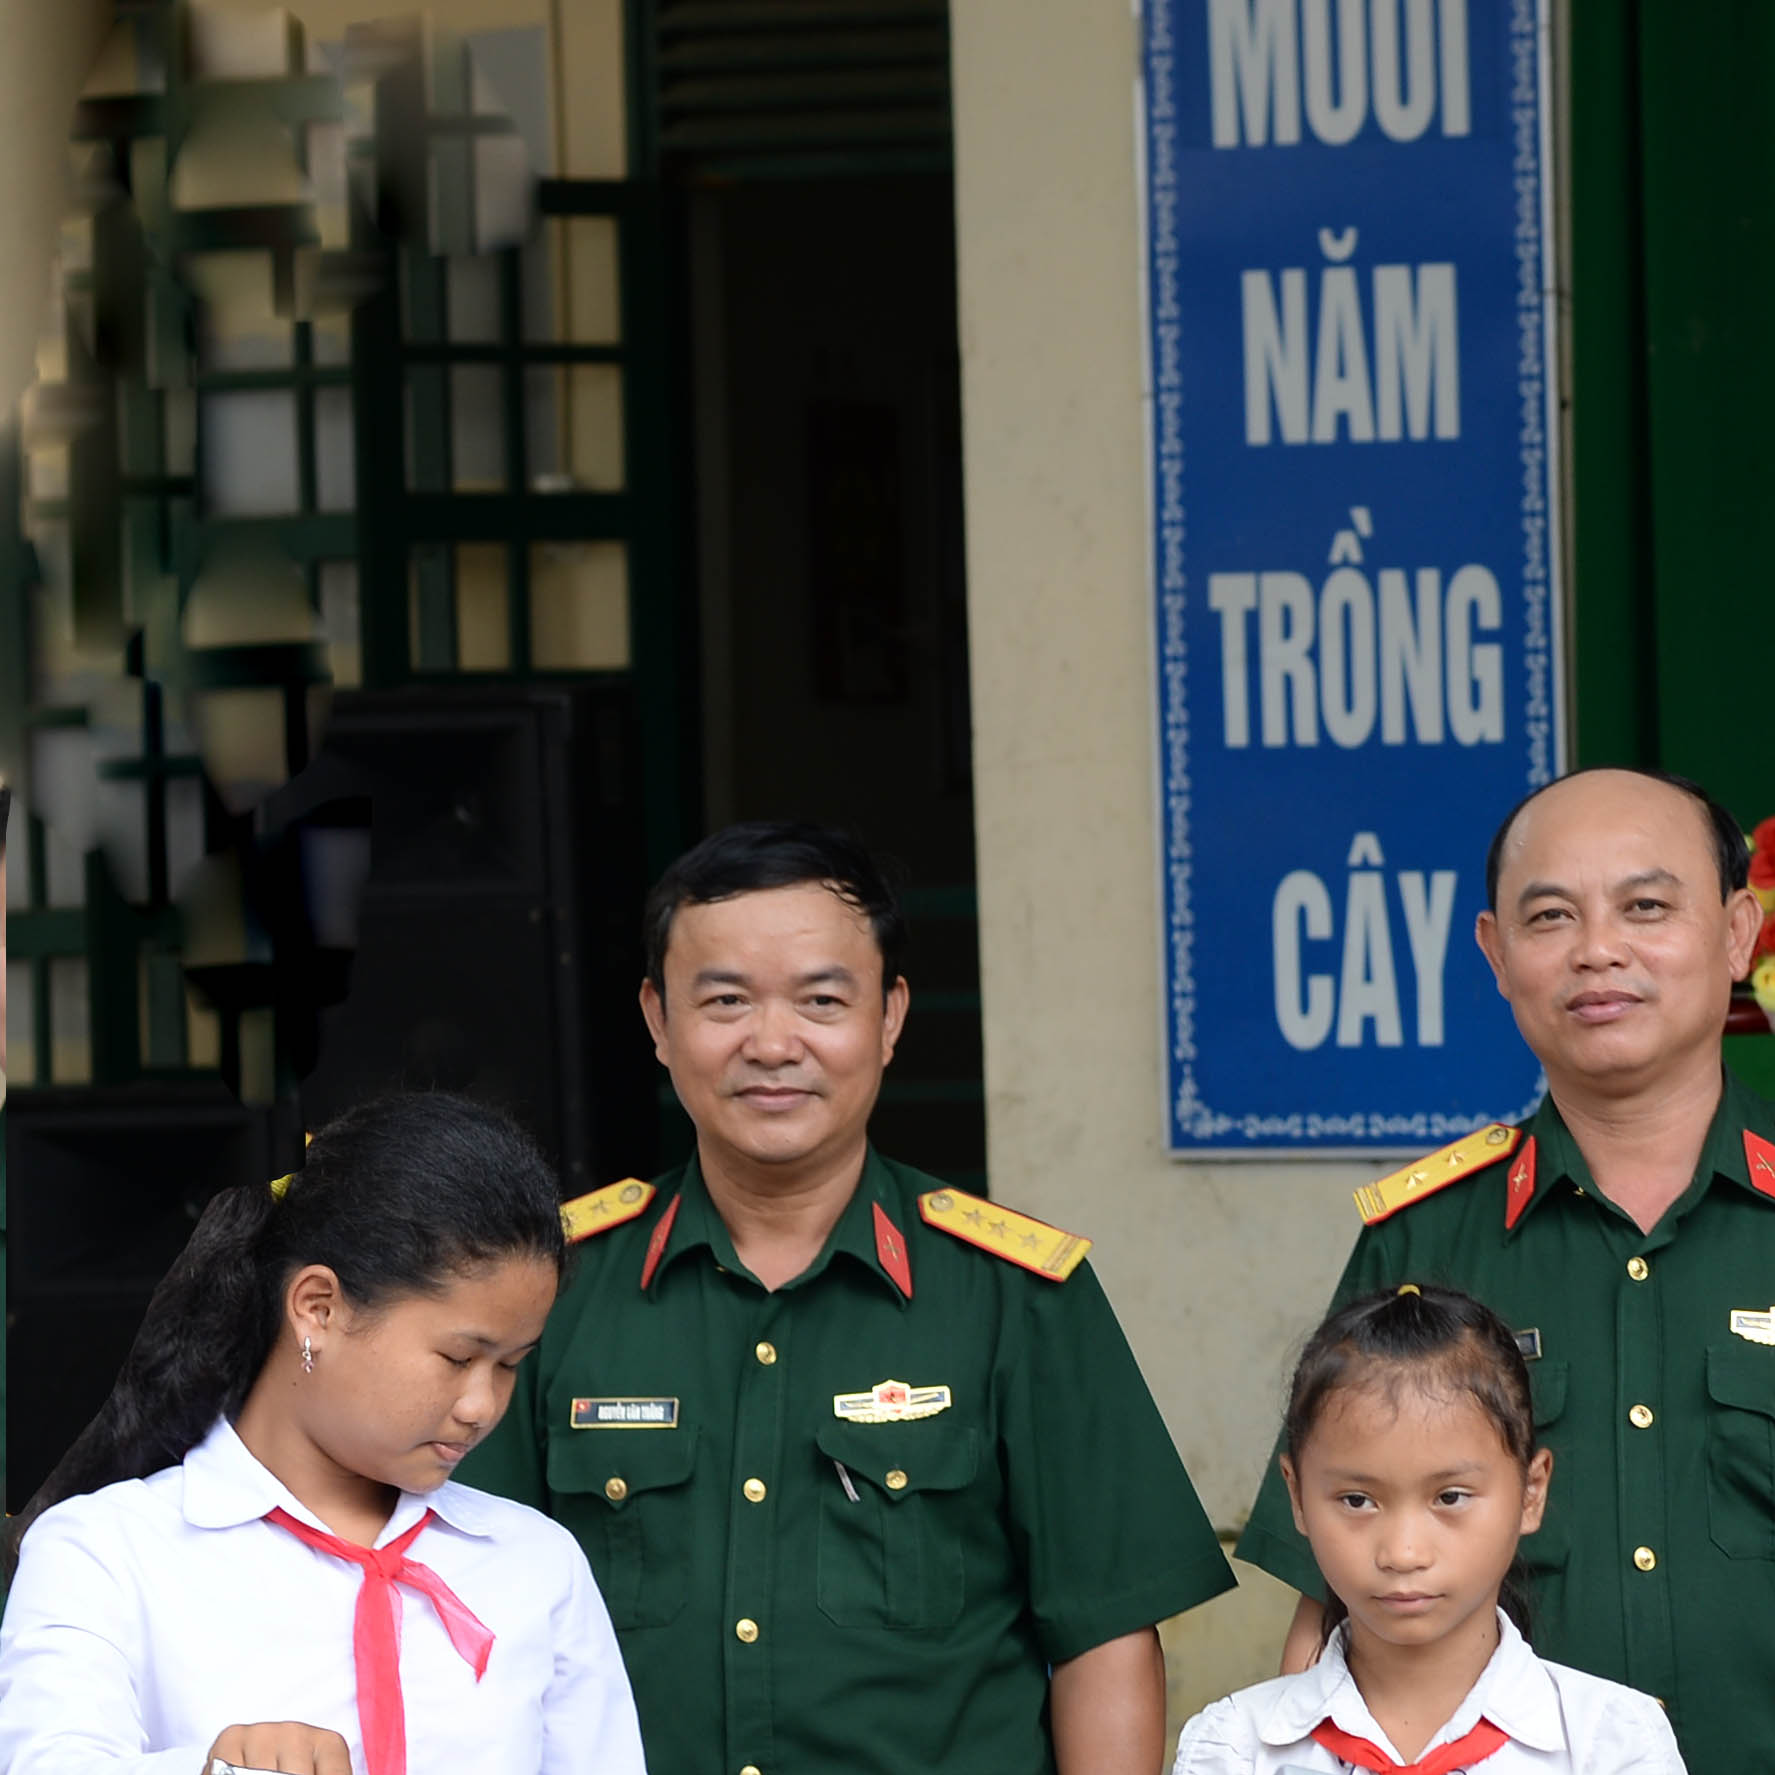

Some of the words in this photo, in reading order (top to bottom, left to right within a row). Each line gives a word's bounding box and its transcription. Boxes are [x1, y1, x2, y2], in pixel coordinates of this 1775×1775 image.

[1244, 228, 1459, 444] NĂM
[1209, 507, 1503, 747] TRỒNG
[1274, 833, 1456, 1049] CÂY
